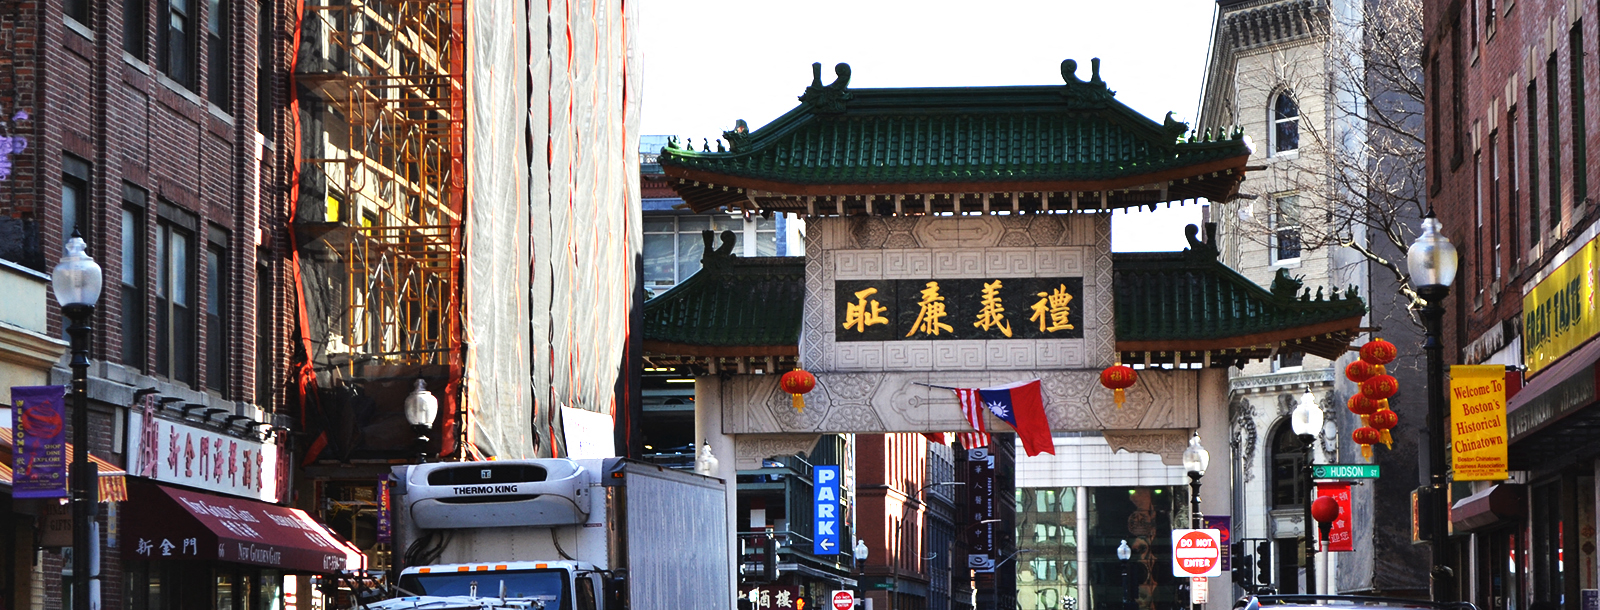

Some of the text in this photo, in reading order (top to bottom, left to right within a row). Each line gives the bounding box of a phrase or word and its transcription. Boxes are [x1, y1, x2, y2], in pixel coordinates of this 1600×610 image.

[1526, 297, 1552, 355] GREAT
[1554, 274, 1581, 337] TASTE
[1454, 380, 1502, 400] Welcome To
[1462, 399, 1500, 416] Boston's
[16, 400, 24, 454] WELCOME
[1456, 415, 1501, 435] Historical
[1454, 435, 1503, 453] Chinatown
[1330, 466, 1377, 477] HUDSON ST
[453, 485, 518, 495] THERMO KING
[817, 469, 835, 535] PARK
[50, 519, 71, 531] GIFTS
[136, 537, 198, 557] 新金門
[218, 543, 225, 558] 66
[1180, 538, 1213, 547] DO NOT
[238, 543, 249, 560] NEW
[1183, 559, 1211, 567] ENTER
